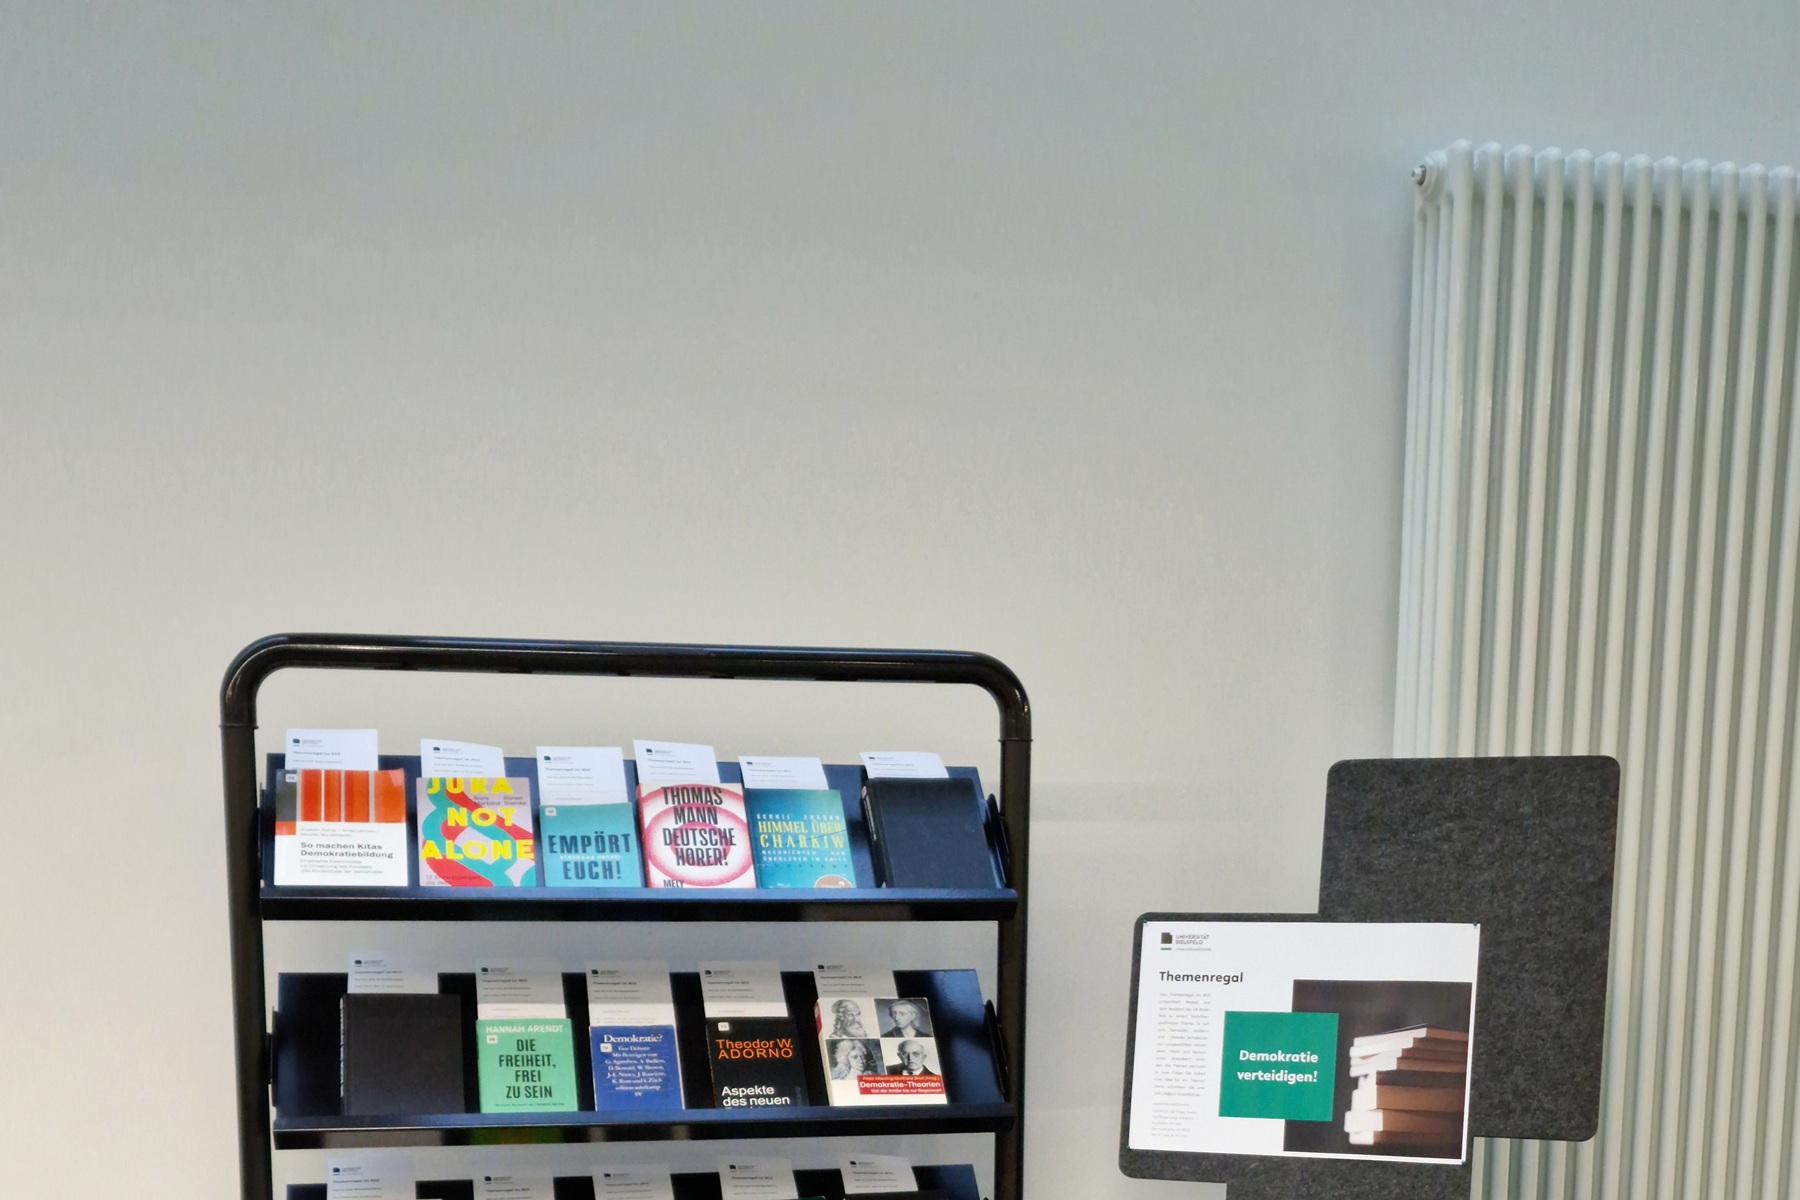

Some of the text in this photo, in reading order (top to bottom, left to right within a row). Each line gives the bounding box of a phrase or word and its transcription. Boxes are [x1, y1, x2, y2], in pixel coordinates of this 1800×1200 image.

[427, 778, 513, 794] JURA
[660, 786, 723, 806] THOMAS
[448, 808, 517, 826] NOT
[673, 806, 718, 824] MANN
[758, 820, 842, 833] HIMMEL ÜBER
[548, 830, 631, 854] EMPÖRT
[662, 828, 736, 846] DEUTSCHE
[760, 834, 844, 848] CHARKIW
[300, 850, 394, 859] Demokratiebildung
[420, 840, 534, 860] ALONE
[562, 860, 622, 880] EUCH!
[663, 880, 684, 888] MELY
[1160, 970, 1244, 986] Themenregal
[527, 1024, 564, 1032] ARENDT
[516, 1038, 536, 1052] DIE
[604, 1034, 663, 1043] Demokratie?
[716, 1038, 793, 1050] Theodor W.
[718, 1048, 793, 1060] ADORNO
[1240, 1050, 1318, 1063] Demokratie
[498, 1054, 556, 1069] FREIHEIT,
[515, 1070, 542, 1082] FREI
[1237, 1070, 1318, 1084] verteidigen!
[506, 1085, 553, 1098] ZU SEIN
[721, 1086, 774, 1097] Aspekte
[722, 1096, 790, 1106] des neuen
